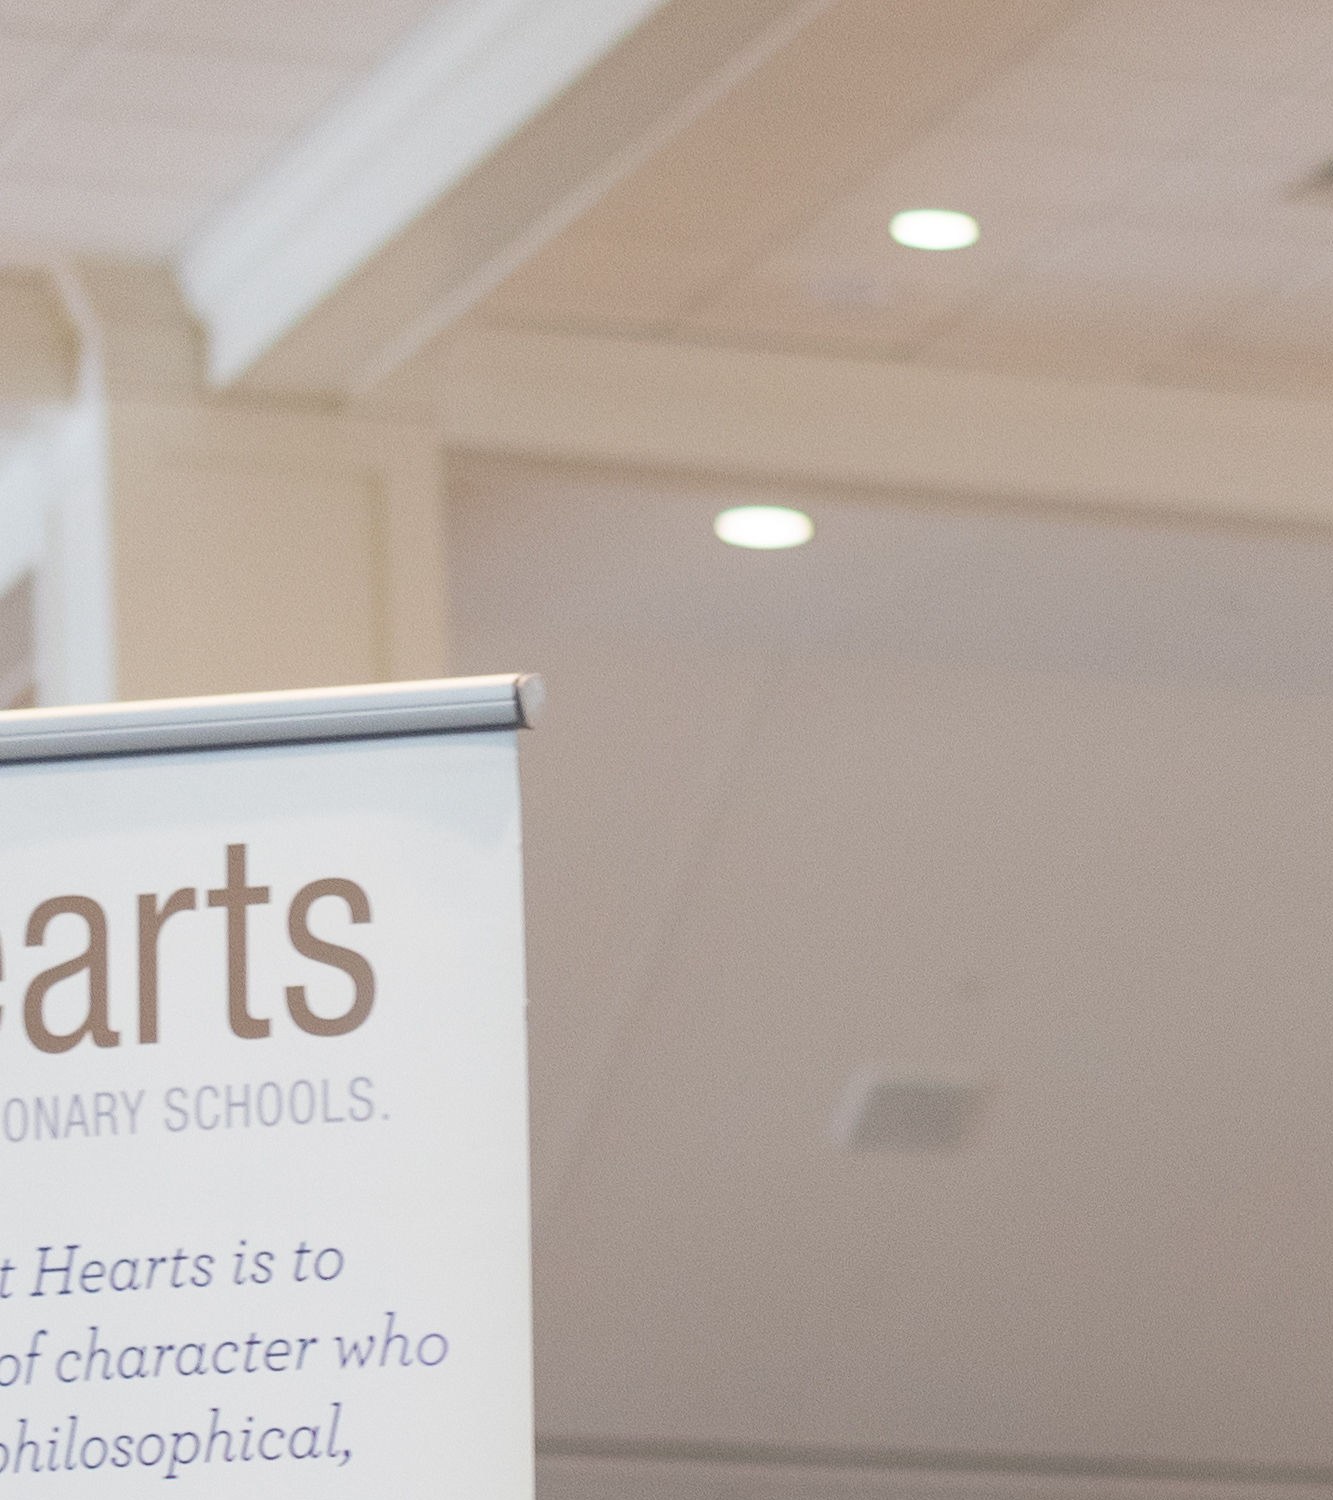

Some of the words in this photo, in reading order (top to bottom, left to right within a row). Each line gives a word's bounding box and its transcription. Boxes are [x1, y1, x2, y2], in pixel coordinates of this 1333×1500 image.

[0, 843, 378, 1054] arts
[2, 1088, 146, 1143] ONARY
[163, 1075, 390, 1133] SCHOOLS.
[29, 1244, 216, 1298] Hearts
[233, 1238, 276, 1286] is
[293, 1240, 346, 1282] to
[0, 1328, 49, 1387] of
[55, 1325, 320, 1384] character
[333, 1311, 450, 1370] who
